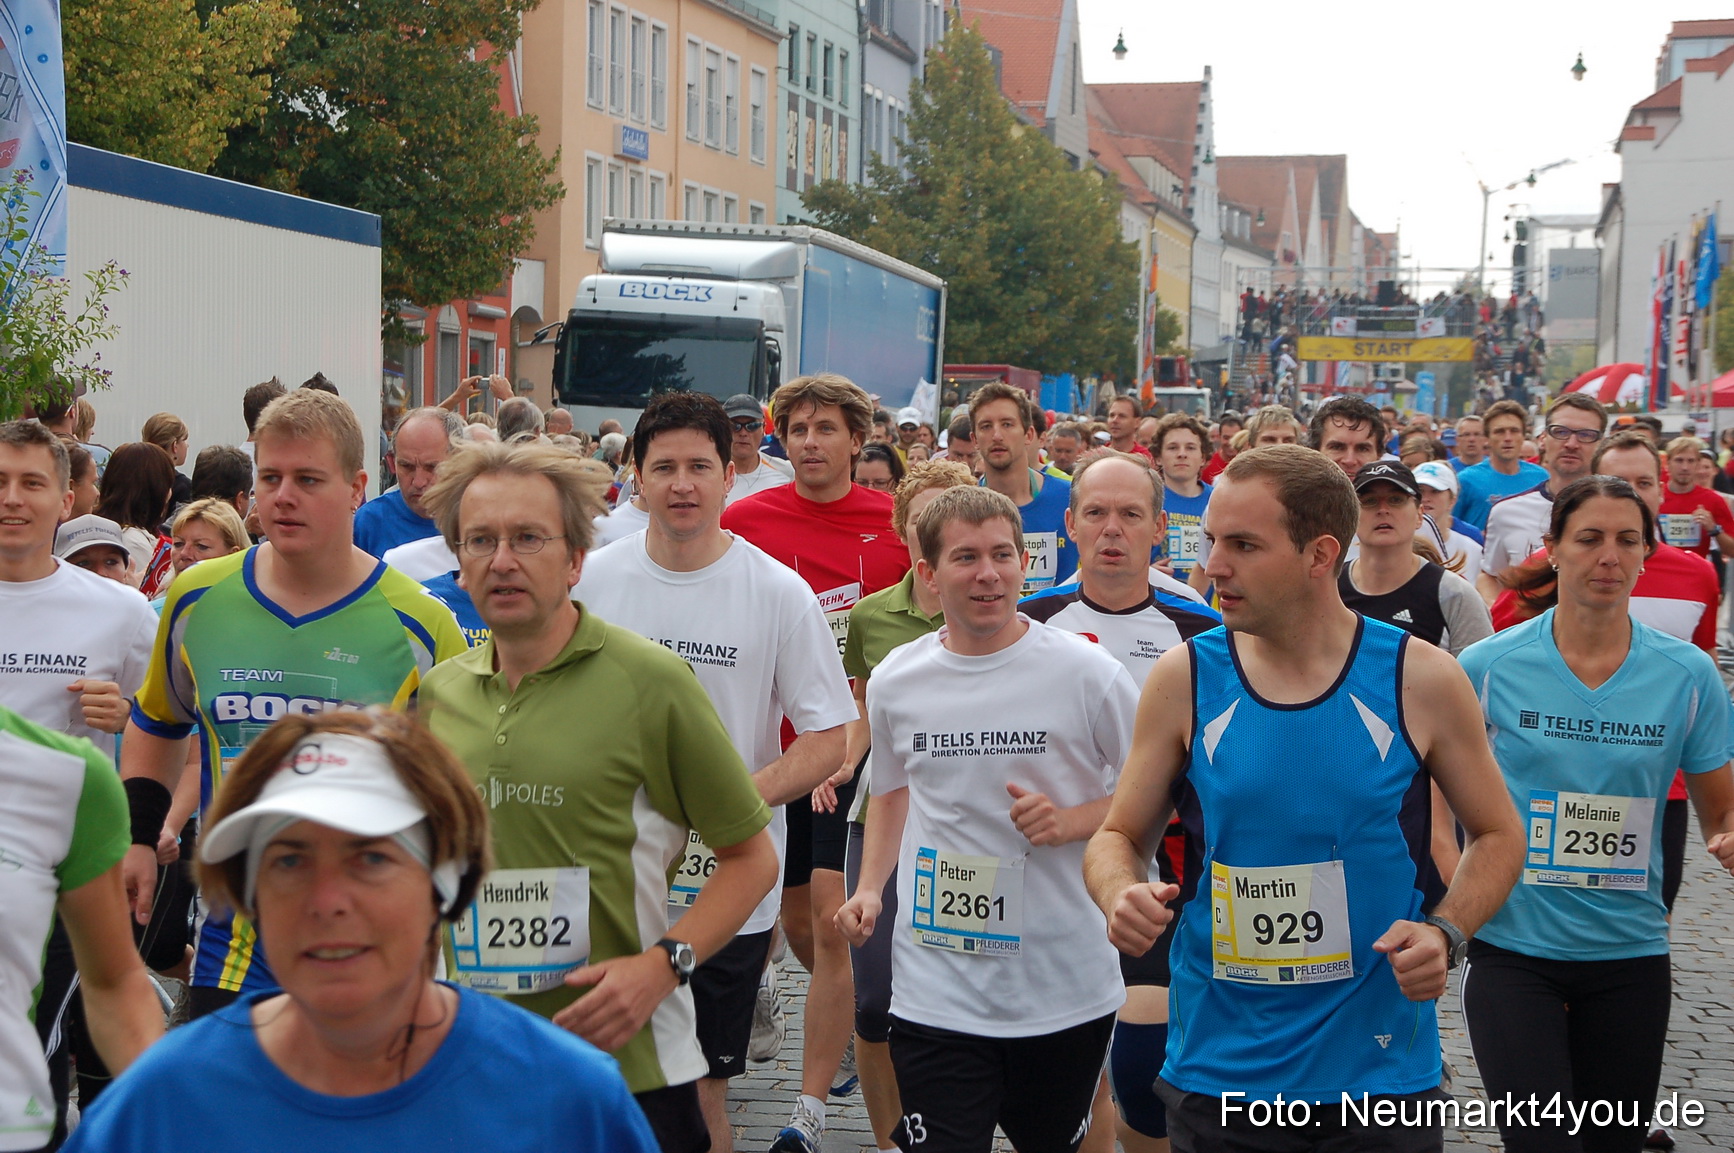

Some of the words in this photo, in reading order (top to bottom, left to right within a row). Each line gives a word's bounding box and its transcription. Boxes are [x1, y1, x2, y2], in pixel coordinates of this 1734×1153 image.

[619, 281, 713, 302] BOCK
[1354, 342, 1413, 356] START
[1029, 555, 1047, 570] 71
[677, 640, 738, 660] FINANZ
[1137, 639, 1154, 647] team
[24, 653, 88, 668] FINANZ
[26, 667, 86, 677] ACHHAMMER
[220, 669, 283, 682] TEAM
[1545, 715, 1594, 733] TELIS
[1600, 721, 1666, 738] FINANZ
[931, 732, 975, 749] TELIS
[980, 731, 1047, 746] FINANZ
[1544, 730, 1599, 743] DIREKTION
[1601, 736, 1664, 747] ACHHAMMER
[931, 748, 981, 758] DIREKTION
[983, 746, 1047, 756] ACHHAMMER
[506, 782, 565, 807] POLES
[1564, 802, 1621, 822] Melanie
[1535, 826, 1543, 839] C
[1563, 830, 1637, 857] 2365
[940, 860, 976, 882] Peter
[483, 880, 549, 904] Hendrik
[920, 884, 926, 897] C
[1235, 876, 1297, 899] Martin
[941, 890, 1005, 922] 2361
[1215, 907, 1222, 924] C
[487, 916, 572, 949] 2382
[1252, 910, 1325, 946] 929
[975, 938, 1020, 952] PFLEIDERER
[1226, 966, 1259, 978] BOCK
[1295, 960, 1350, 976] PFLEIDERER
